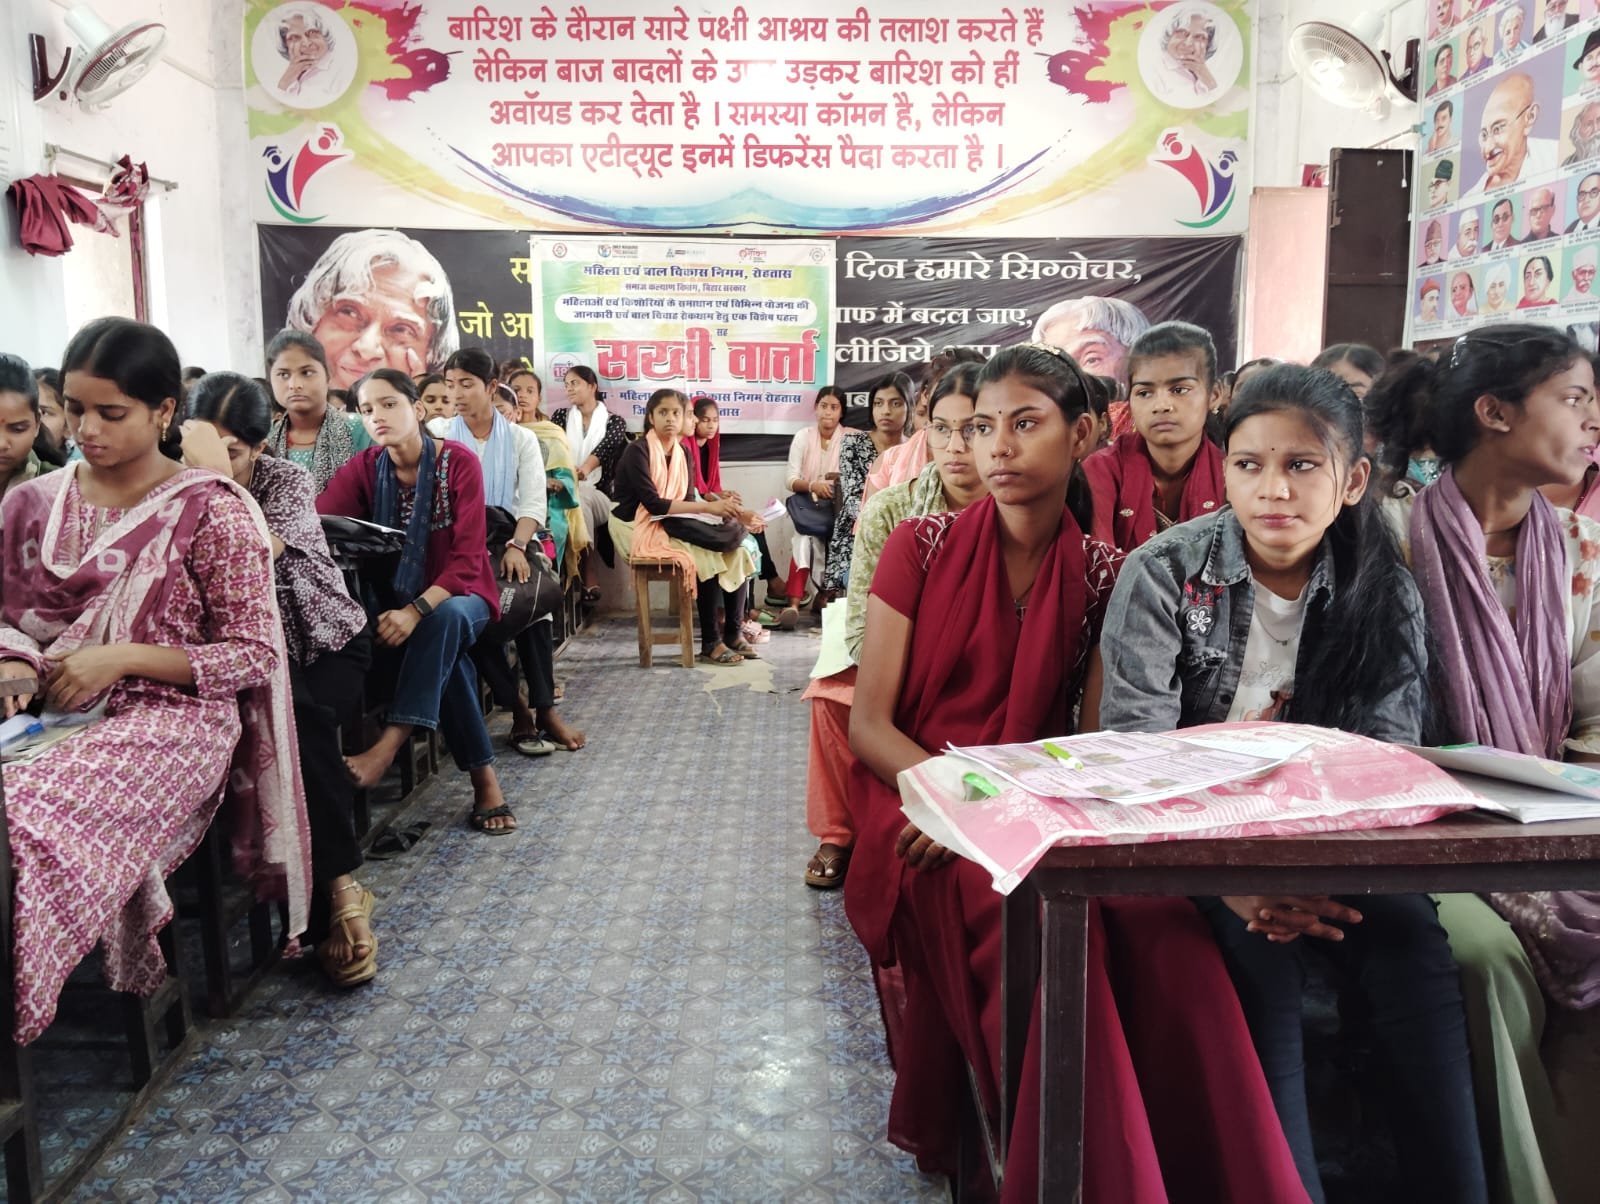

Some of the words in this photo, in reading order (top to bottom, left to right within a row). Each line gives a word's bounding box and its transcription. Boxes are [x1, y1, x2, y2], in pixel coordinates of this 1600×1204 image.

[447, 5, 523, 43] बारिश
[530, 6, 558, 41] के
[566, 5, 635, 42] दौरान
[643, 6, 690, 41] सारे
[697, 6, 749, 42] पक्षी
[759, 17, 828, 42] आश्रय
[837, 7, 871, 42] की
[880, 18, 949, 44] तलाश
[957, 8, 1018, 43] करते
[1024, 8, 1045, 46] हैं
[473, 48, 548, 83] लेकिन
[556, 58, 604, 83] बाज
[611, 48, 684, 84] बादलों
[692, 48, 718, 83] के
[785, 59, 861, 89] उड़कर
[869, 49, 943, 86] बारिश
[950, 49, 985, 84] को
[993, 48, 1020, 88] हीं
[491, 91, 572, 125] अवॉयड
[580, 100, 622, 125] कर
[630, 90, 675, 126] देता
[680, 90, 701, 130] है
[729, 101, 807, 127] समस्या
[816, 93, 887, 126] कॉमन
[893, 92, 921, 131] है,
[933, 91, 1005, 125] लेकिन
[493, 143, 572, 168] आपका
[581, 132, 674, 177] एटीट्यूट
[681, 133, 735, 174] इनमें
[743, 133, 832, 169] डिफरेंस
[838, 135, 883, 168] पैदा
[893, 144, 957, 168] करता
[965, 135, 983, 173] है
[584, 263, 620, 276] महिला
[624, 264, 641, 276] एवं
[670, 264, 709, 278] विकास
[711, 265, 749, 280] निगम,
[752, 266, 793, 279] रोहतास
[844, 250, 908, 281] दिन
[914, 251, 994, 282] हमारे
[1000, 251, 1142, 283] सिग्नेचर,
[459, 302, 493, 339] जो
[574, 309, 613, 319] जानकारी
[732, 313, 747, 321] एक
[776, 313, 799, 322] पहल
[881, 301, 906, 324] में
[911, 307, 972, 326] बदल
[976, 308, 1033, 329] जाए,
[593, 327, 713, 382] सखी
[726, 329, 821, 384] वार्ता
[836, 337, 935, 363] लीजिये
[733, 391, 763, 402] निगम
[764, 391, 802, 403] रोहतास
